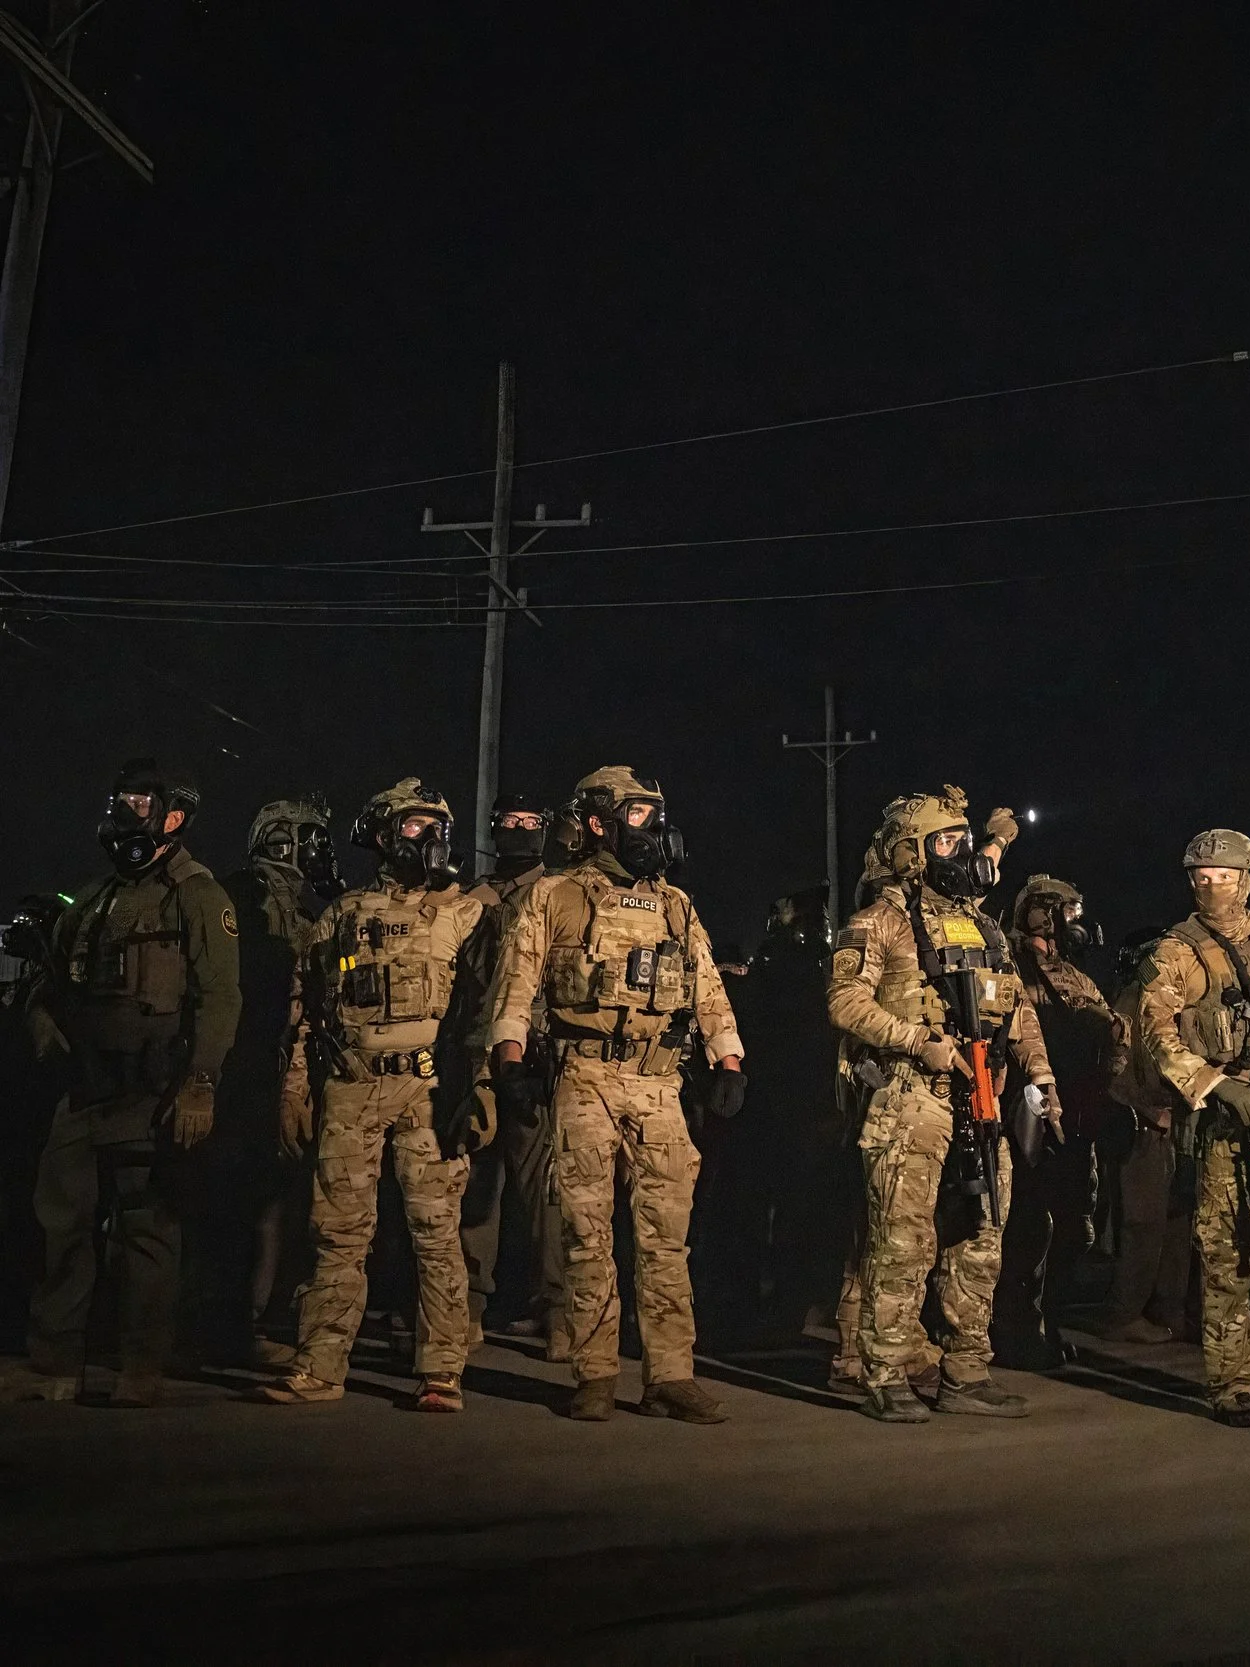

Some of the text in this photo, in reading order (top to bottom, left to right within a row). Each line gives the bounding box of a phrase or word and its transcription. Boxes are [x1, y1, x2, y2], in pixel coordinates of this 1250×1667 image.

[622, 897, 656, 911] POLICE
[359, 923, 408, 940] PICE
[945, 922, 976, 933] POLIC
